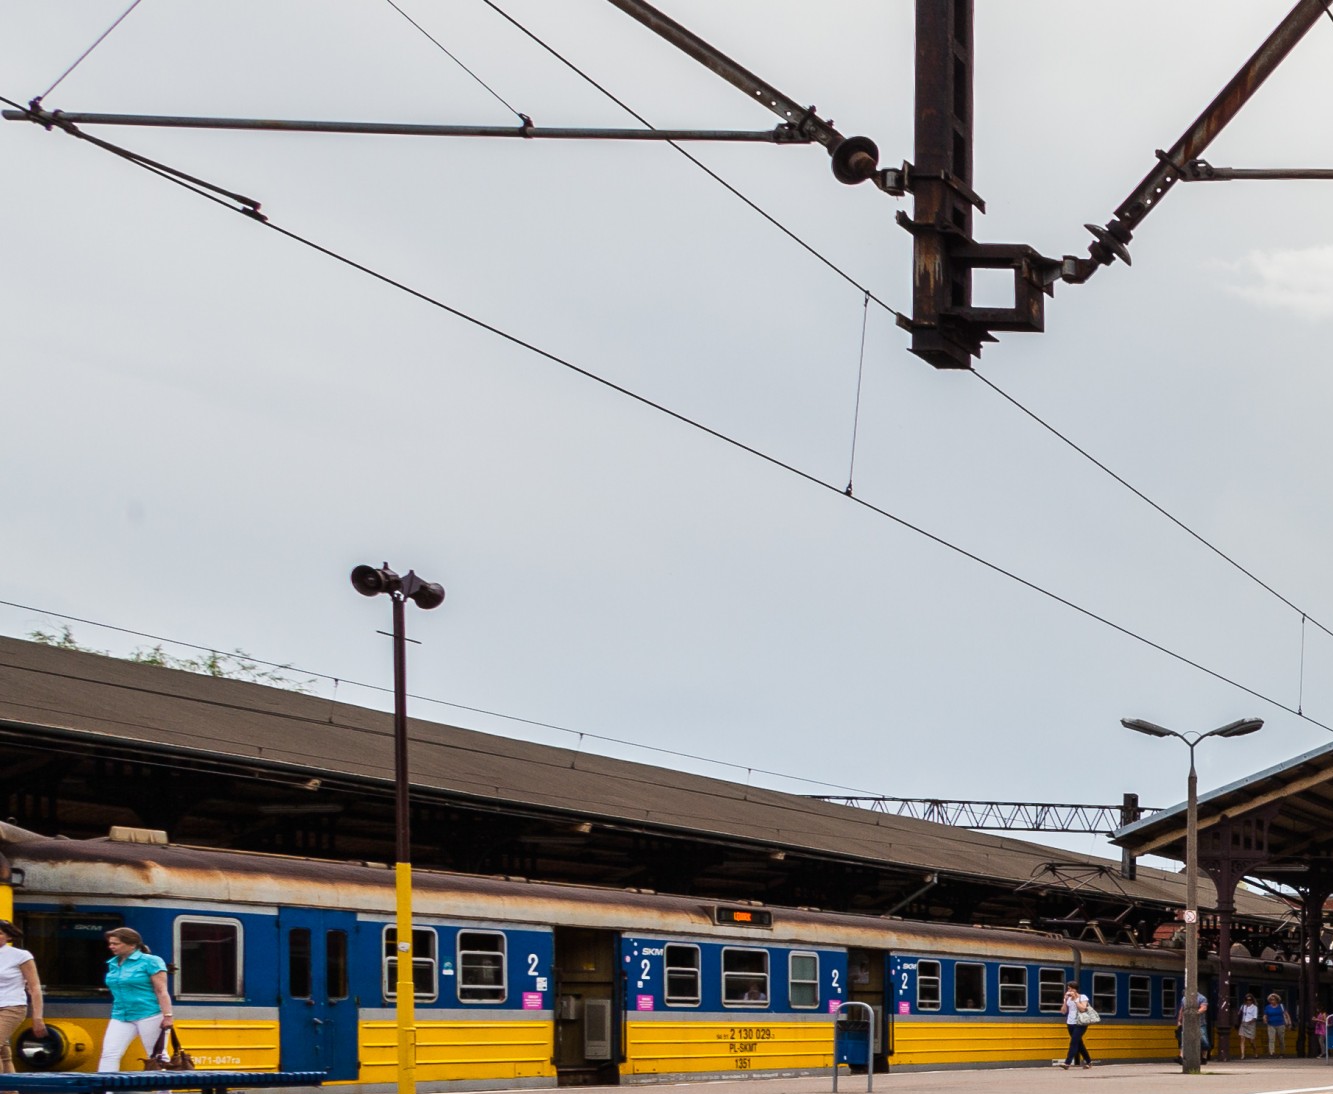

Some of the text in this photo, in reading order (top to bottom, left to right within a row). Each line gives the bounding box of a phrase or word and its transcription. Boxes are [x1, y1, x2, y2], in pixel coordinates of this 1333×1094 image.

[642, 948, 664, 956] SKM
[527, 954, 539, 976] 2
[640, 958, 650, 980] 2
[832, 969, 839, 987] 2
[902, 972, 908, 989] 2
[730, 1028, 735, 1040] 2
[739, 1028, 753, 1040] 130
[736, 1058, 750, 1068] 1351
